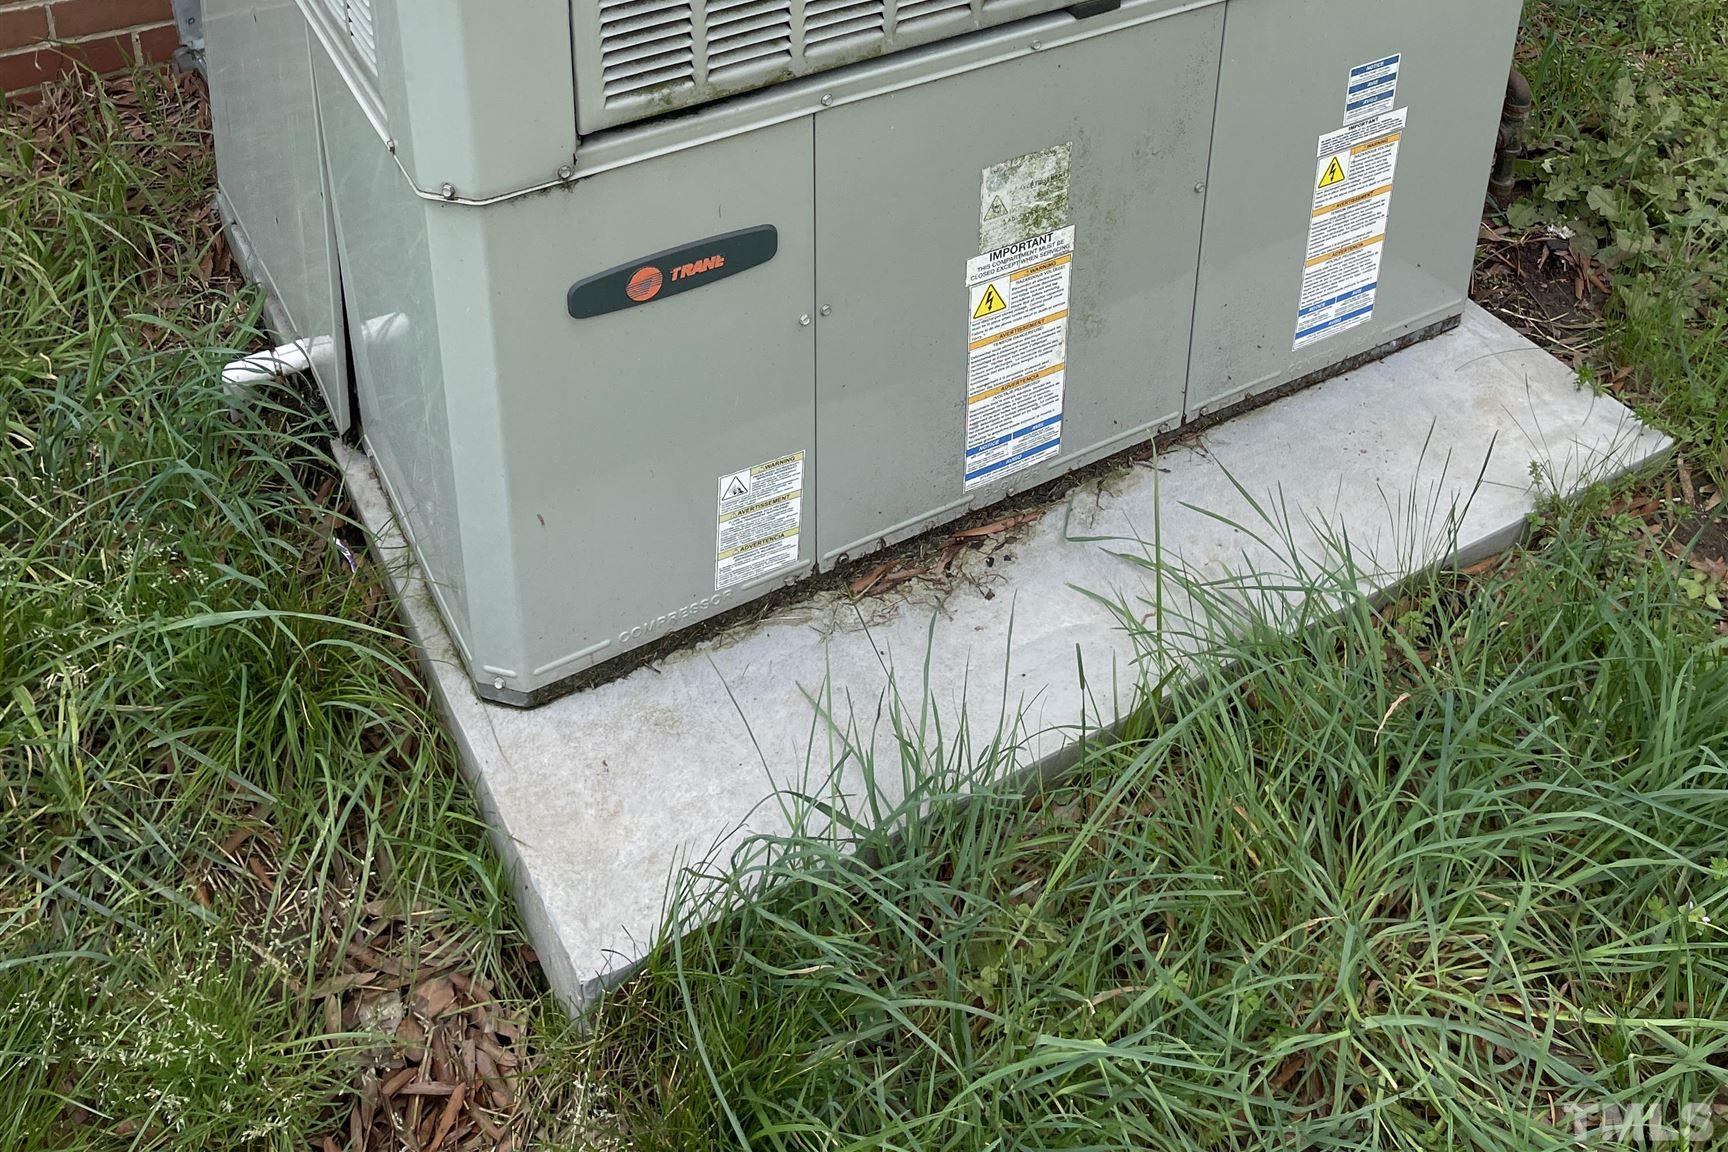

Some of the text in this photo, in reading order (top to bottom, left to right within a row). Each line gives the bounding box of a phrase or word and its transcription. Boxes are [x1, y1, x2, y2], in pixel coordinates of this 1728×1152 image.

[1348, 117, 1379, 131] IMPORTANT
[989, 232, 1054, 262] IMPORTANT
[970, 268, 995, 280] CLOSED
[996, 260, 1019, 272] EXCEPT
[1020, 254, 1038, 265] WHEN
[1040, 244, 1070, 258] SERVICING
[977, 262, 991, 272] THIS
[992, 248, 1037, 268] COMPARTMENT
[1039, 242, 1055, 252] MUST
[670, 254, 727, 281] TRANE
[1030, 261, 1057, 274] WARNING
[999, 319, 1045, 338] AVERTISSEMENT
[1000, 374, 1040, 391] ADVERTENCIA
[978, 439, 1000, 452] NOTICE
[764, 456, 796, 470] WARNING
[1005, 454, 1023, 465] AVISO
[737, 494, 791, 516] AVERTISSEMENT
[739, 532, 785, 552] ADVERTENCIA
[618, 589, 735, 643] COMPRESSOR
